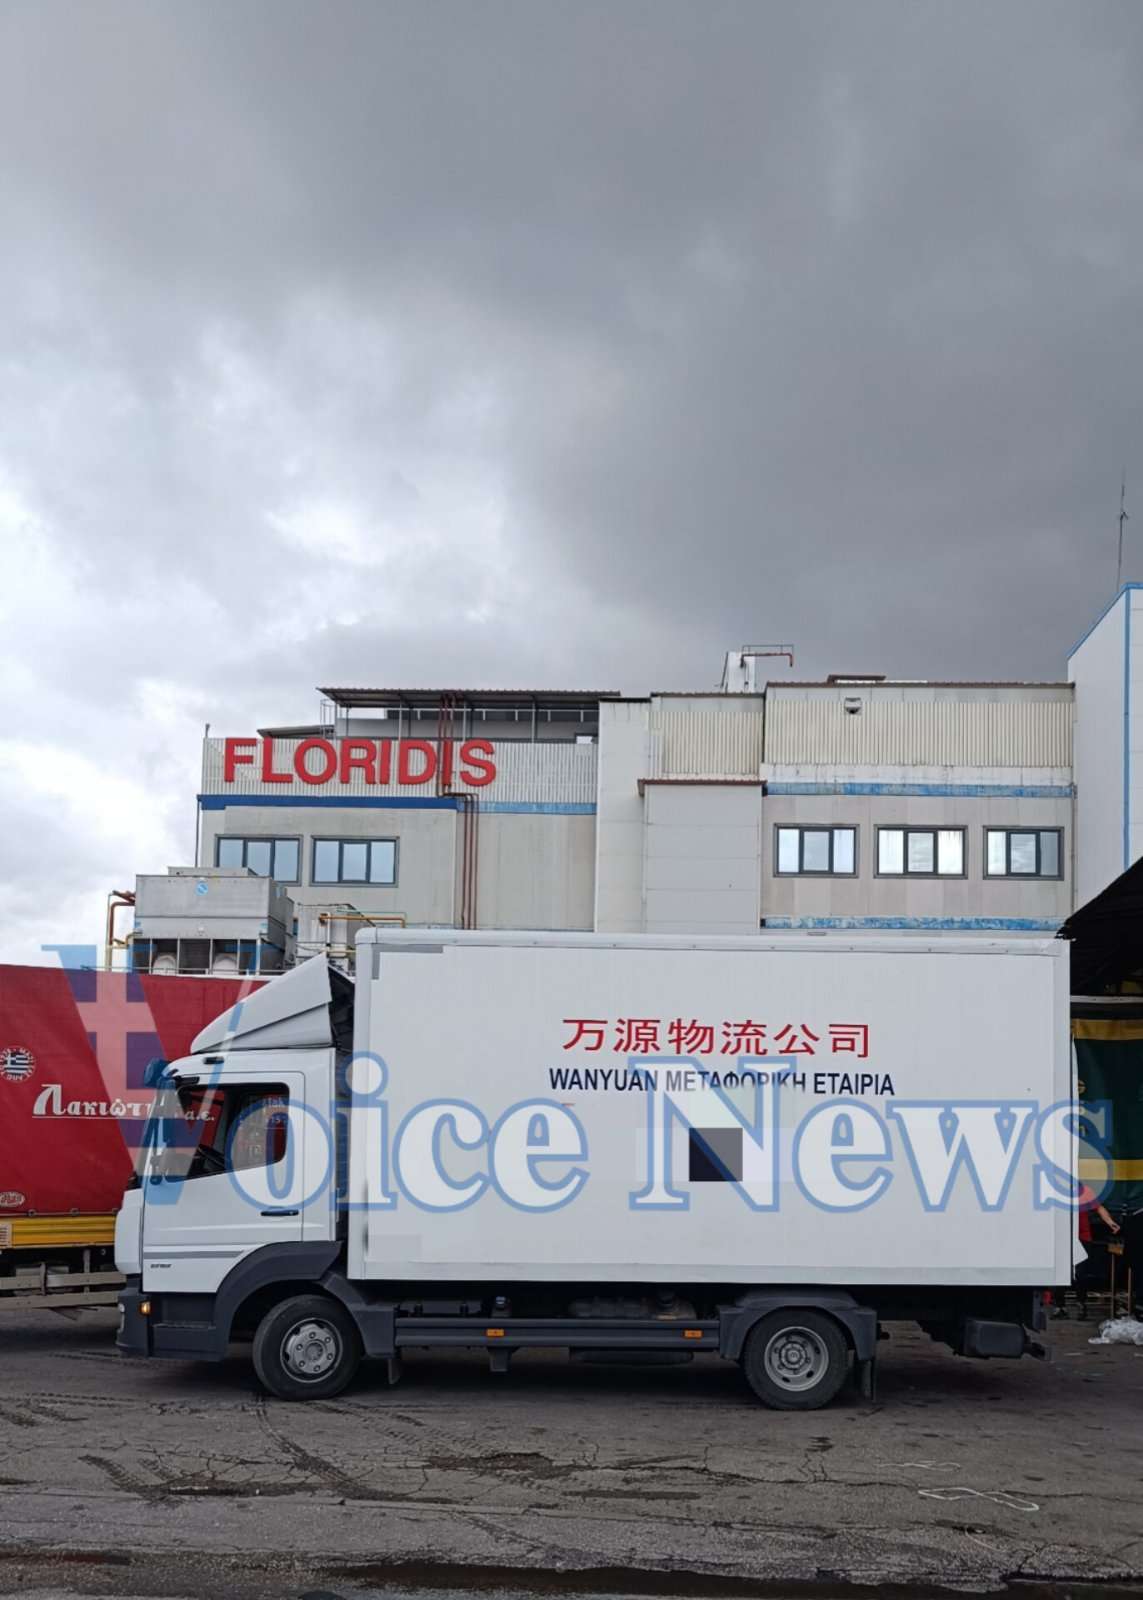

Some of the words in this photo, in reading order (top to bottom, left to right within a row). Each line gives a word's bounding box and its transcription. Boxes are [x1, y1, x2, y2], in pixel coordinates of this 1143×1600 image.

[224, 737, 497, 787] FLORIDIS
[562, 1018, 869, 1058] 万源物流公司
[549, 1068, 658, 1091] WANYUAN
[813, 1072, 895, 1095] ΕΤΑΙΡΙΑ
